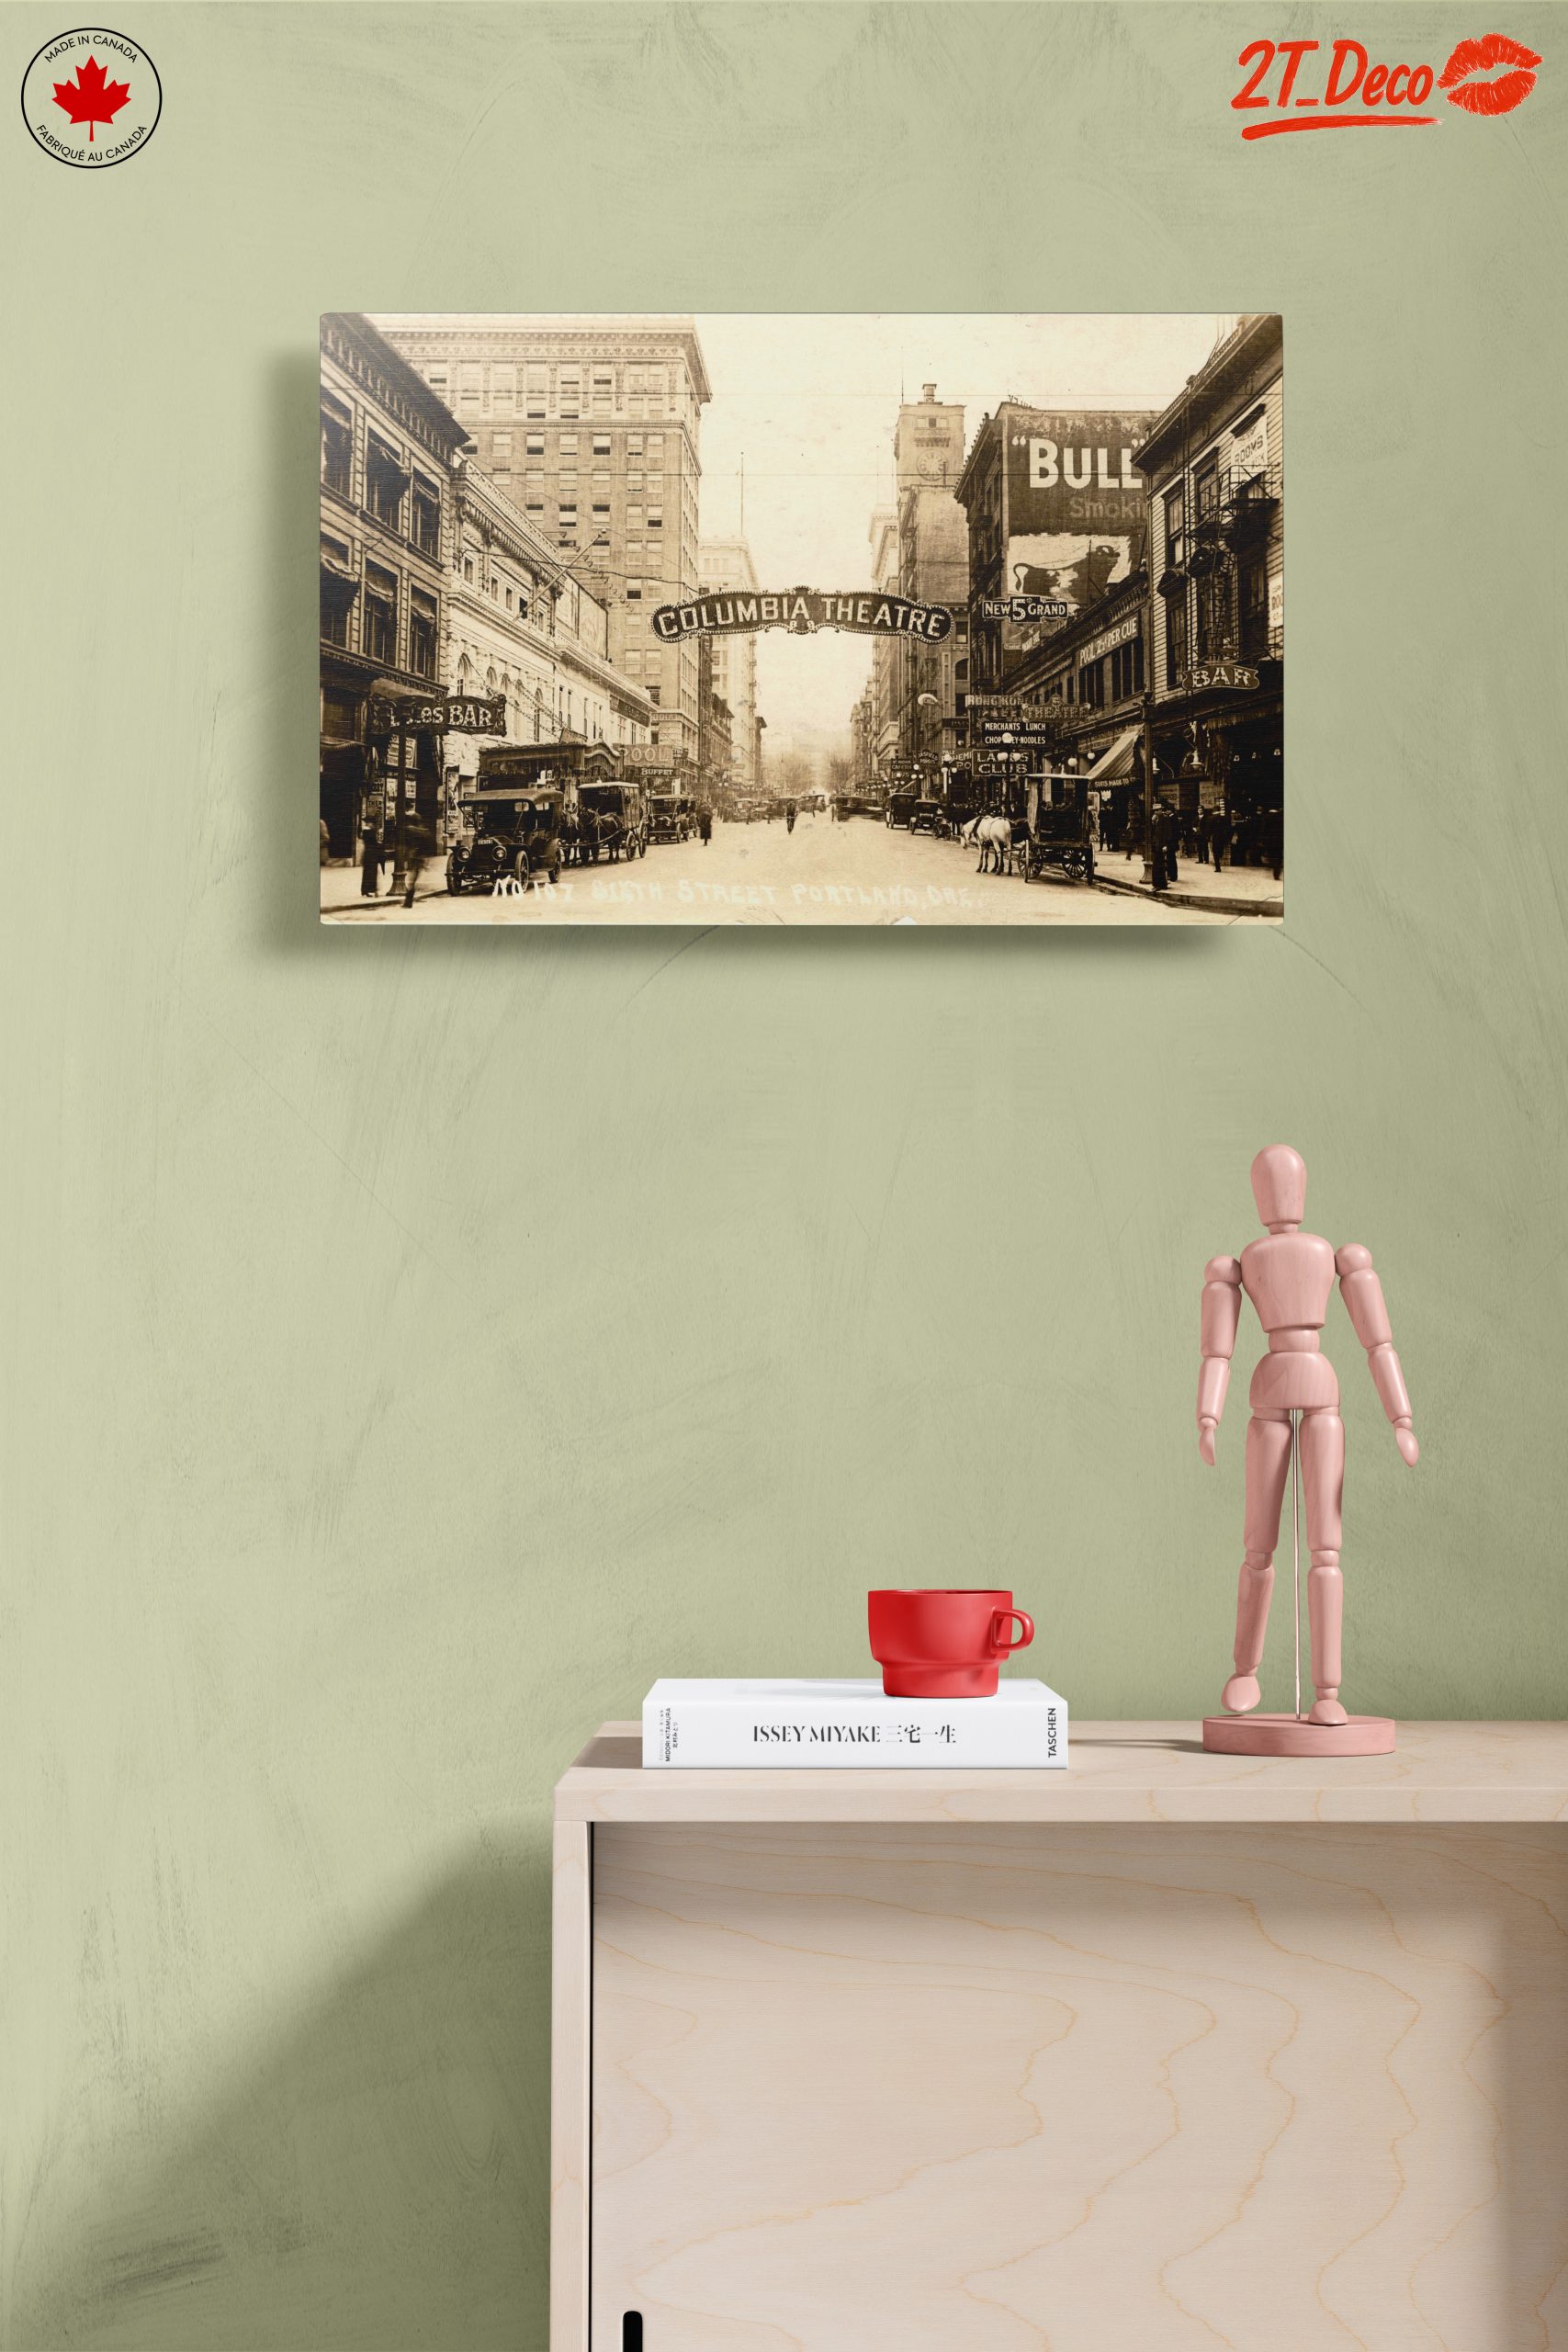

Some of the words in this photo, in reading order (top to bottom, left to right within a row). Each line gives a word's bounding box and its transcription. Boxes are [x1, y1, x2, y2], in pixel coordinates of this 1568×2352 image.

[1069, 496, 1147, 518] Smoki
[658, 597, 810, 636] COLUMBIA
[820, 597, 946, 638] THEATRE
[985, 602, 1010, 616] NEW
[1027, 603, 1066, 616] GRAND
[1079, 642, 1096, 667] POOL
[1107, 628, 1121, 648] PER
[1121, 617, 1137, 639] CUE
[1191, 667, 1251, 688] BAR
[448, 704, 493, 727] BAR
[985, 722, 1021, 731] MERCHANTS
[1025, 722, 1046, 731] LUNCH
[985, 736, 1002, 744] CHOP
[618, 747, 670, 763] POOL
[641, 767, 674, 776] BUFFET
[978, 763, 1028, 774] CLUB
[676, 879, 778, 905] STREET
[753, 1725, 807, 1743] ISSEY
[809, 1725, 881, 1743] MIYAKE
[886, 1724, 956, 1743] 三宅一生
[1047, 1707, 1057, 1758] TASCHEN
